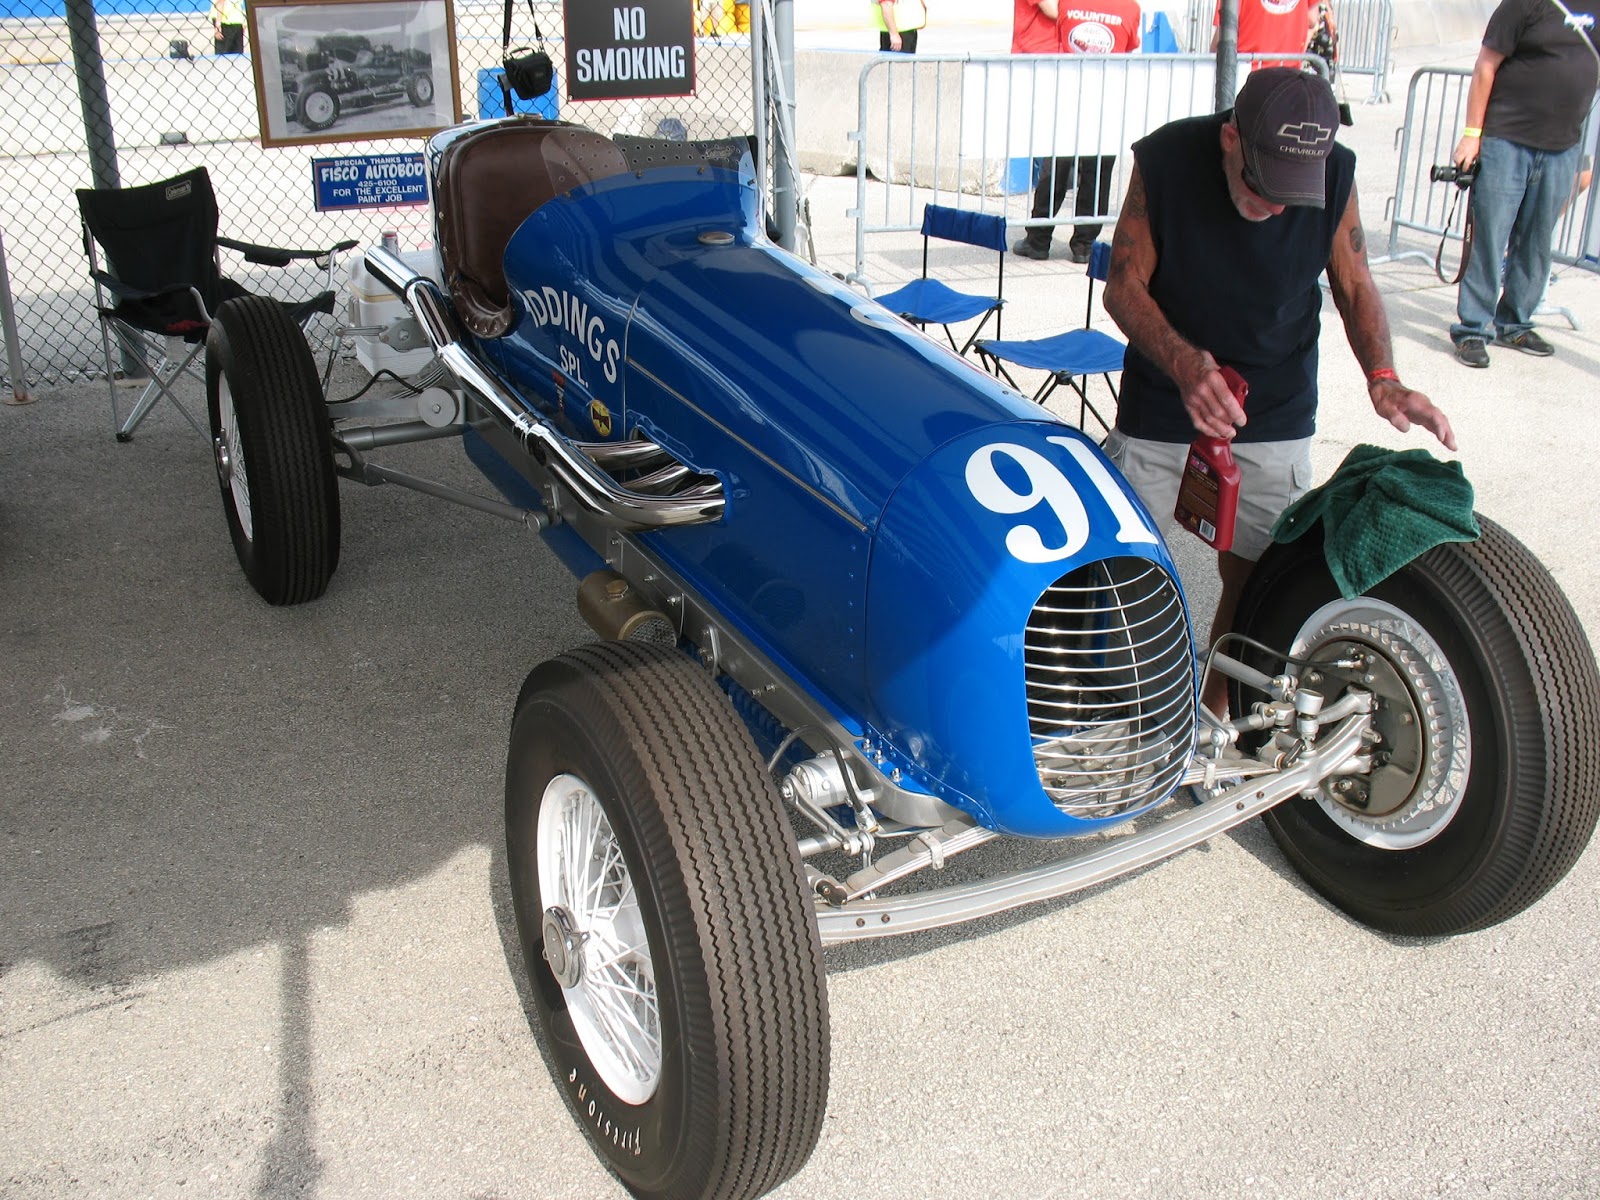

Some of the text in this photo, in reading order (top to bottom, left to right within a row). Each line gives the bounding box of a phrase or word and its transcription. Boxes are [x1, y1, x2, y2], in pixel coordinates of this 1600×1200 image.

[613, 6, 646, 40] NO
[1067, 9, 1122, 26] VOLUNTEER
[576, 45, 686, 82] SMOKING
[1279, 145, 1325, 156] CHEVROLET
[334, 159, 367, 167] SPECIAL
[370, 156, 401, 164] THANKS
[321, 162, 425, 182] FISCO AUTOBOD
[333, 184, 424, 197] FOR THE EXCELLENT
[357, 179, 398, 188] 425-6100
[357, 194, 403, 204] PAINT JOB
[560, 344, 589, 388] SPL.
[965, 436, 1158, 563] 91
